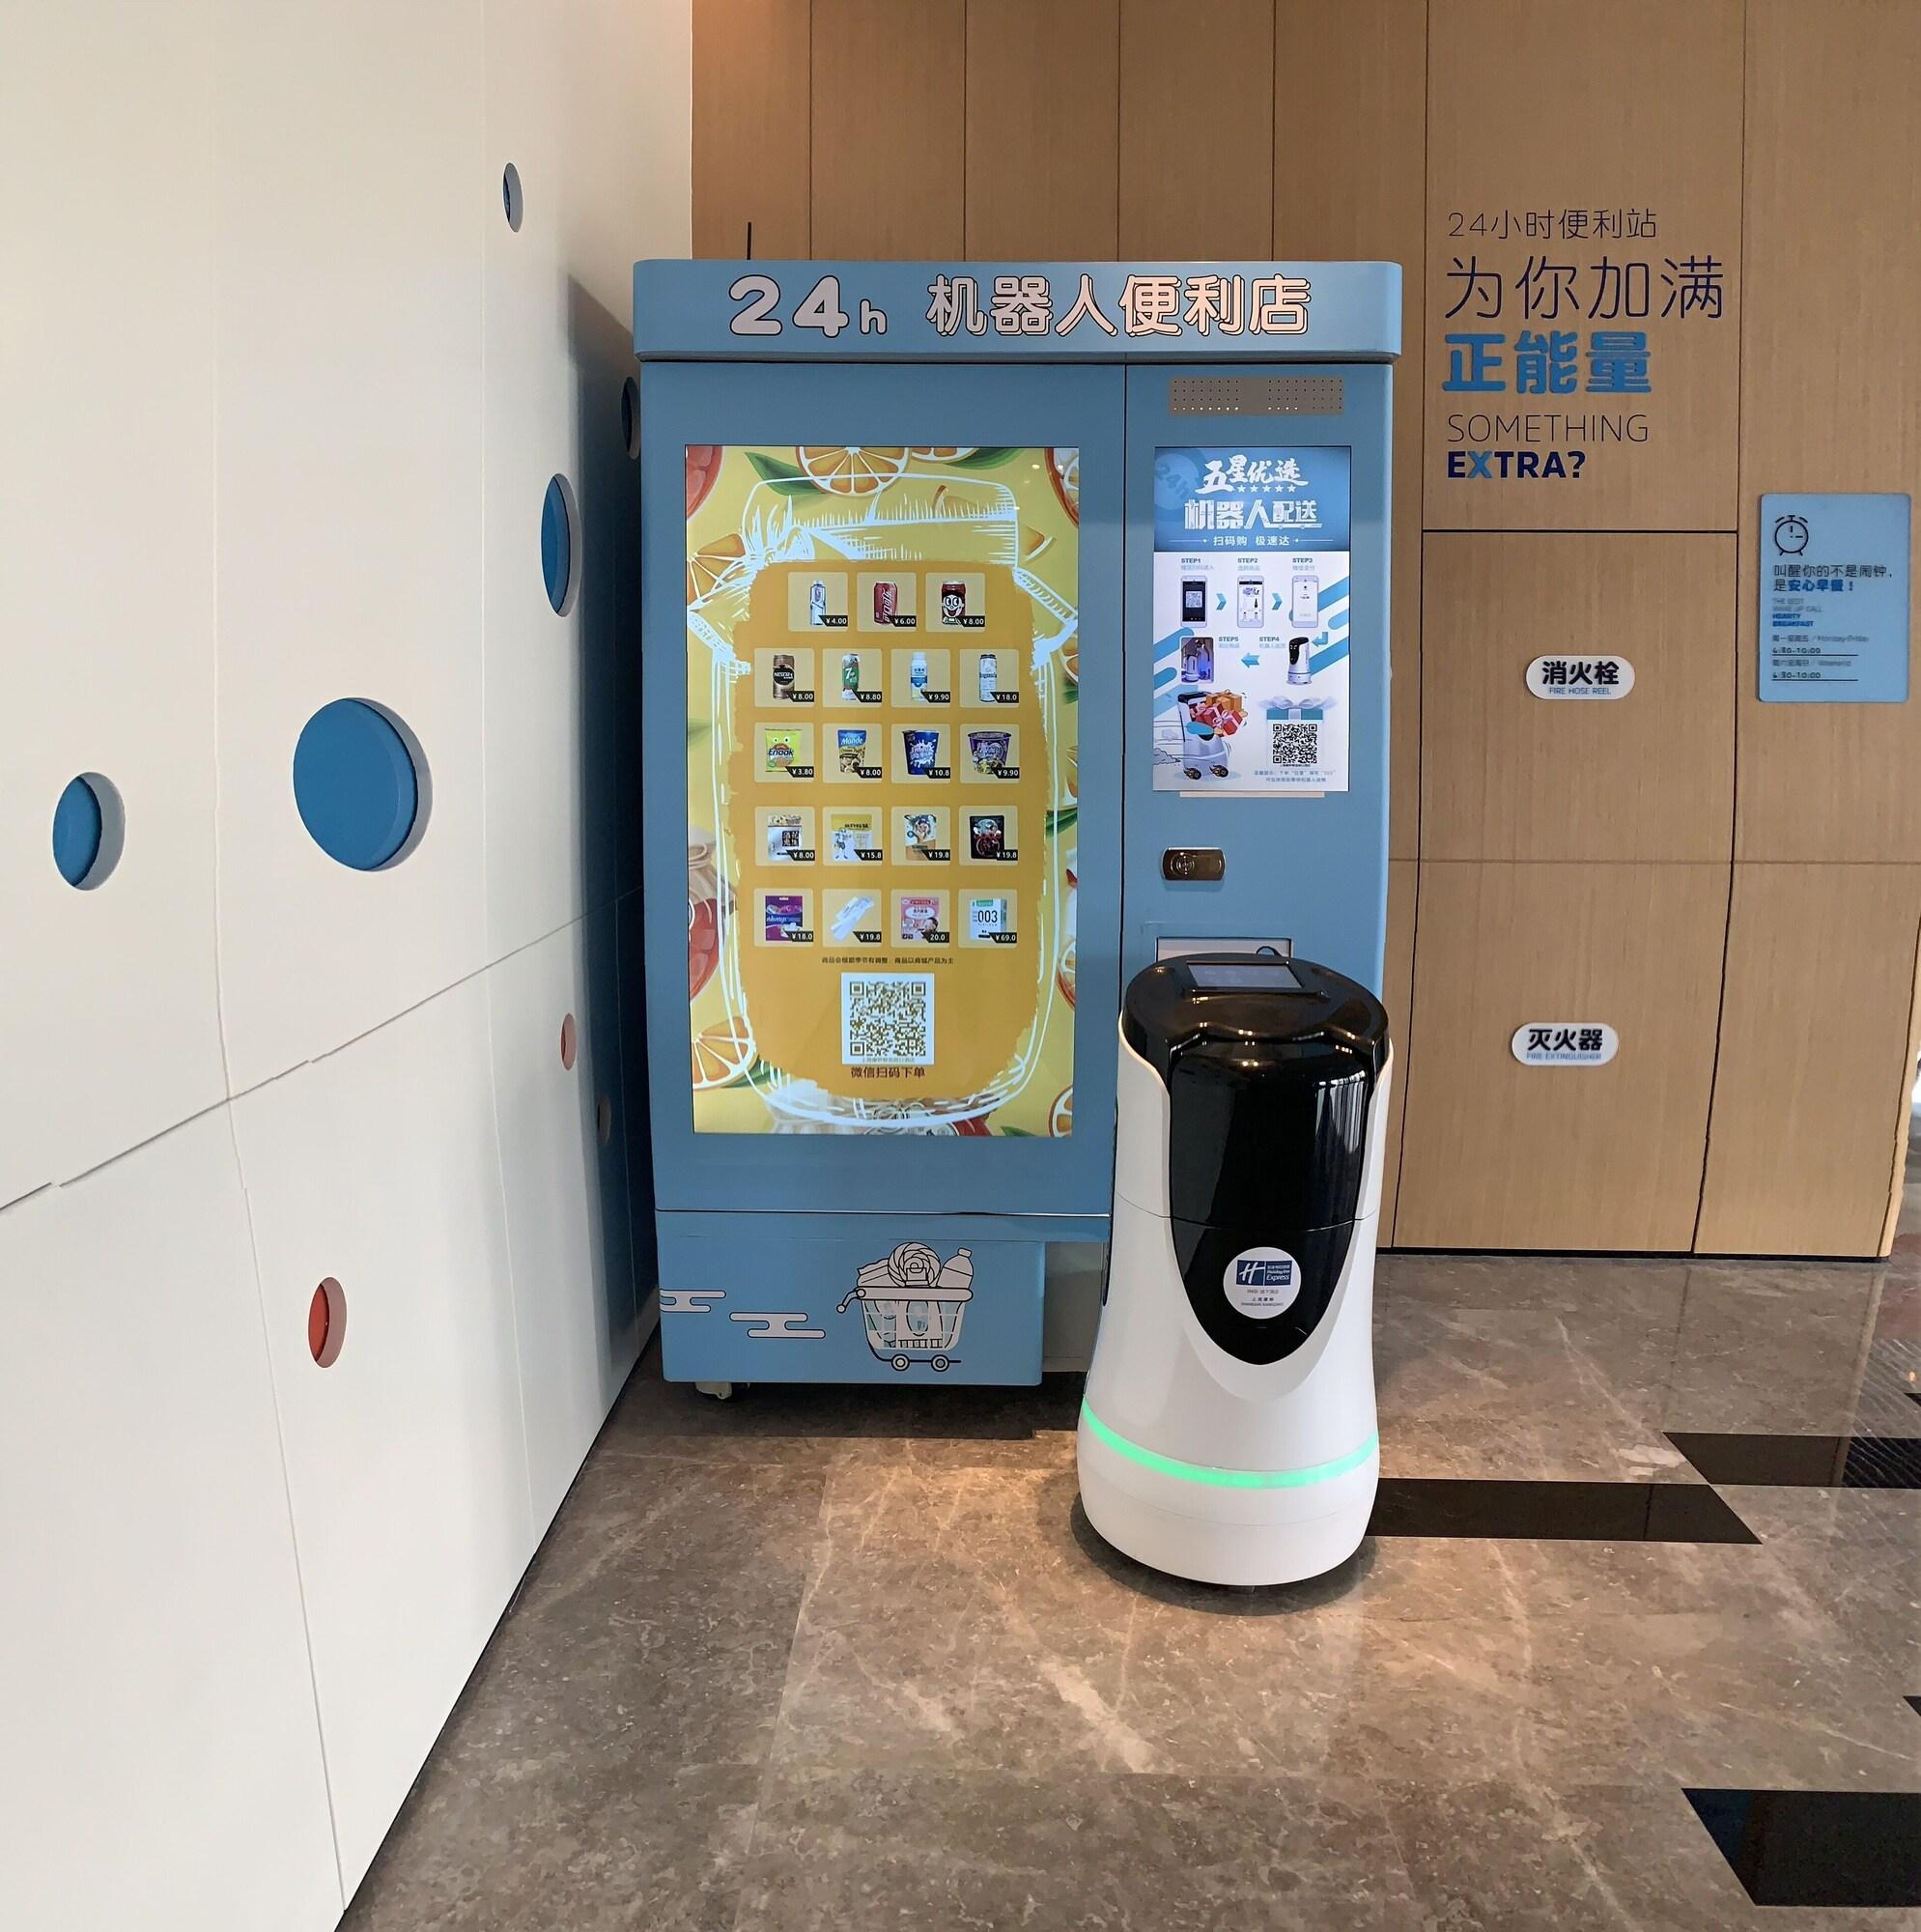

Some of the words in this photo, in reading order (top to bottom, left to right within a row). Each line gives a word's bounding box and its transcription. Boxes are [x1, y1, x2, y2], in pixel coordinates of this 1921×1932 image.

[1448, 209, 1657, 239] 24小时便利站
[1445, 255, 1724, 319] 为你加满
[926, 274, 1311, 337] 机器人便利店
[1441, 330, 1652, 394] 正能量
[1448, 414, 1649, 441] SOMETHING
[1195, 454, 1309, 495] 五星优选
[1448, 451, 1586, 479] EXTRA?
[1184, 498, 1322, 530] 机器人配送
[1213, 535, 1248, 547] 扫码购
[1256, 535, 1290, 547] 极速达
[1542, 661, 1620, 685] 消火栓
[977, 910, 999, 923] 003
[1528, 1029, 1603, 1051] 灭火器
[851, 1065, 925, 1078] 微信扫码下单
